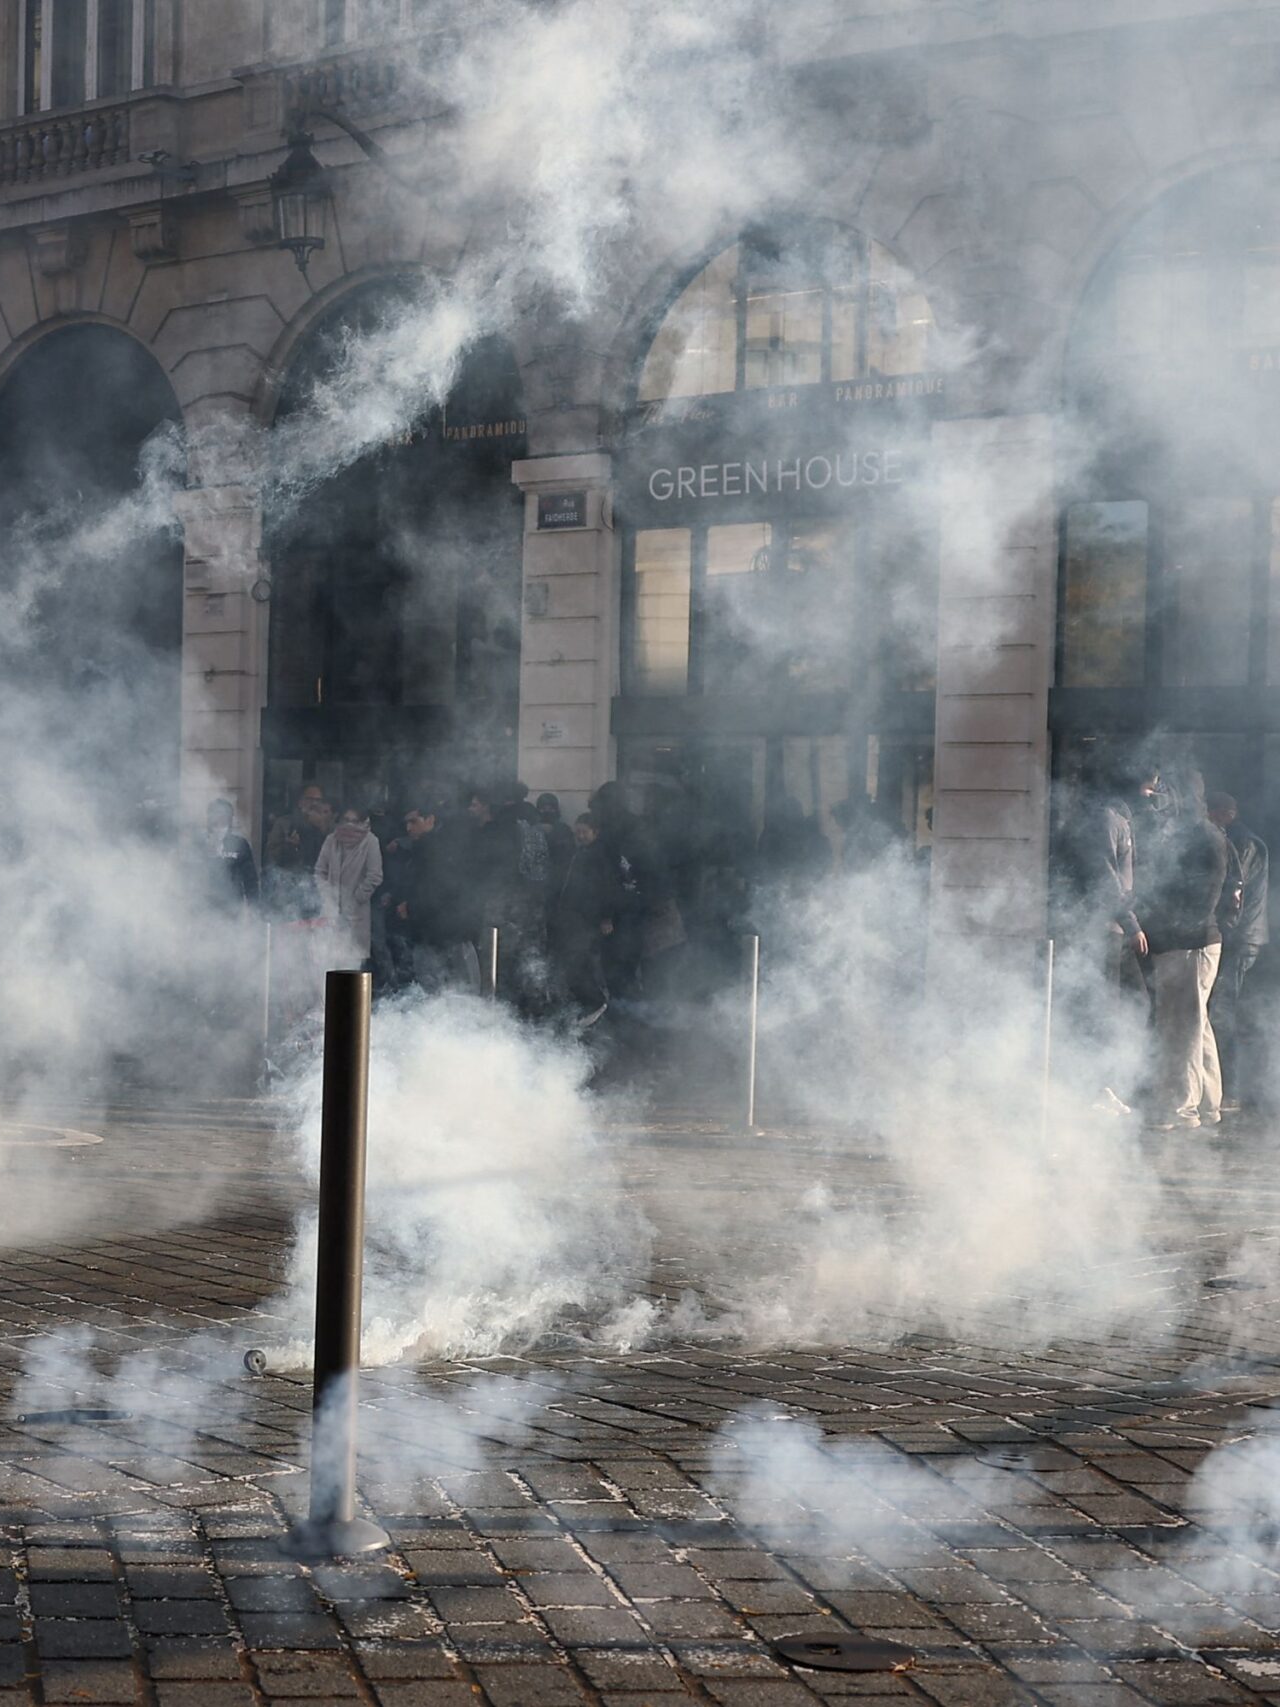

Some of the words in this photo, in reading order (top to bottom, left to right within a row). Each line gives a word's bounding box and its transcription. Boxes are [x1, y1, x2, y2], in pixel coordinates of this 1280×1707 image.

[767, 391, 798, 409] BAR
[648, 460, 768, 501] GREEN
[776, 450, 904, 492] HOUSE
